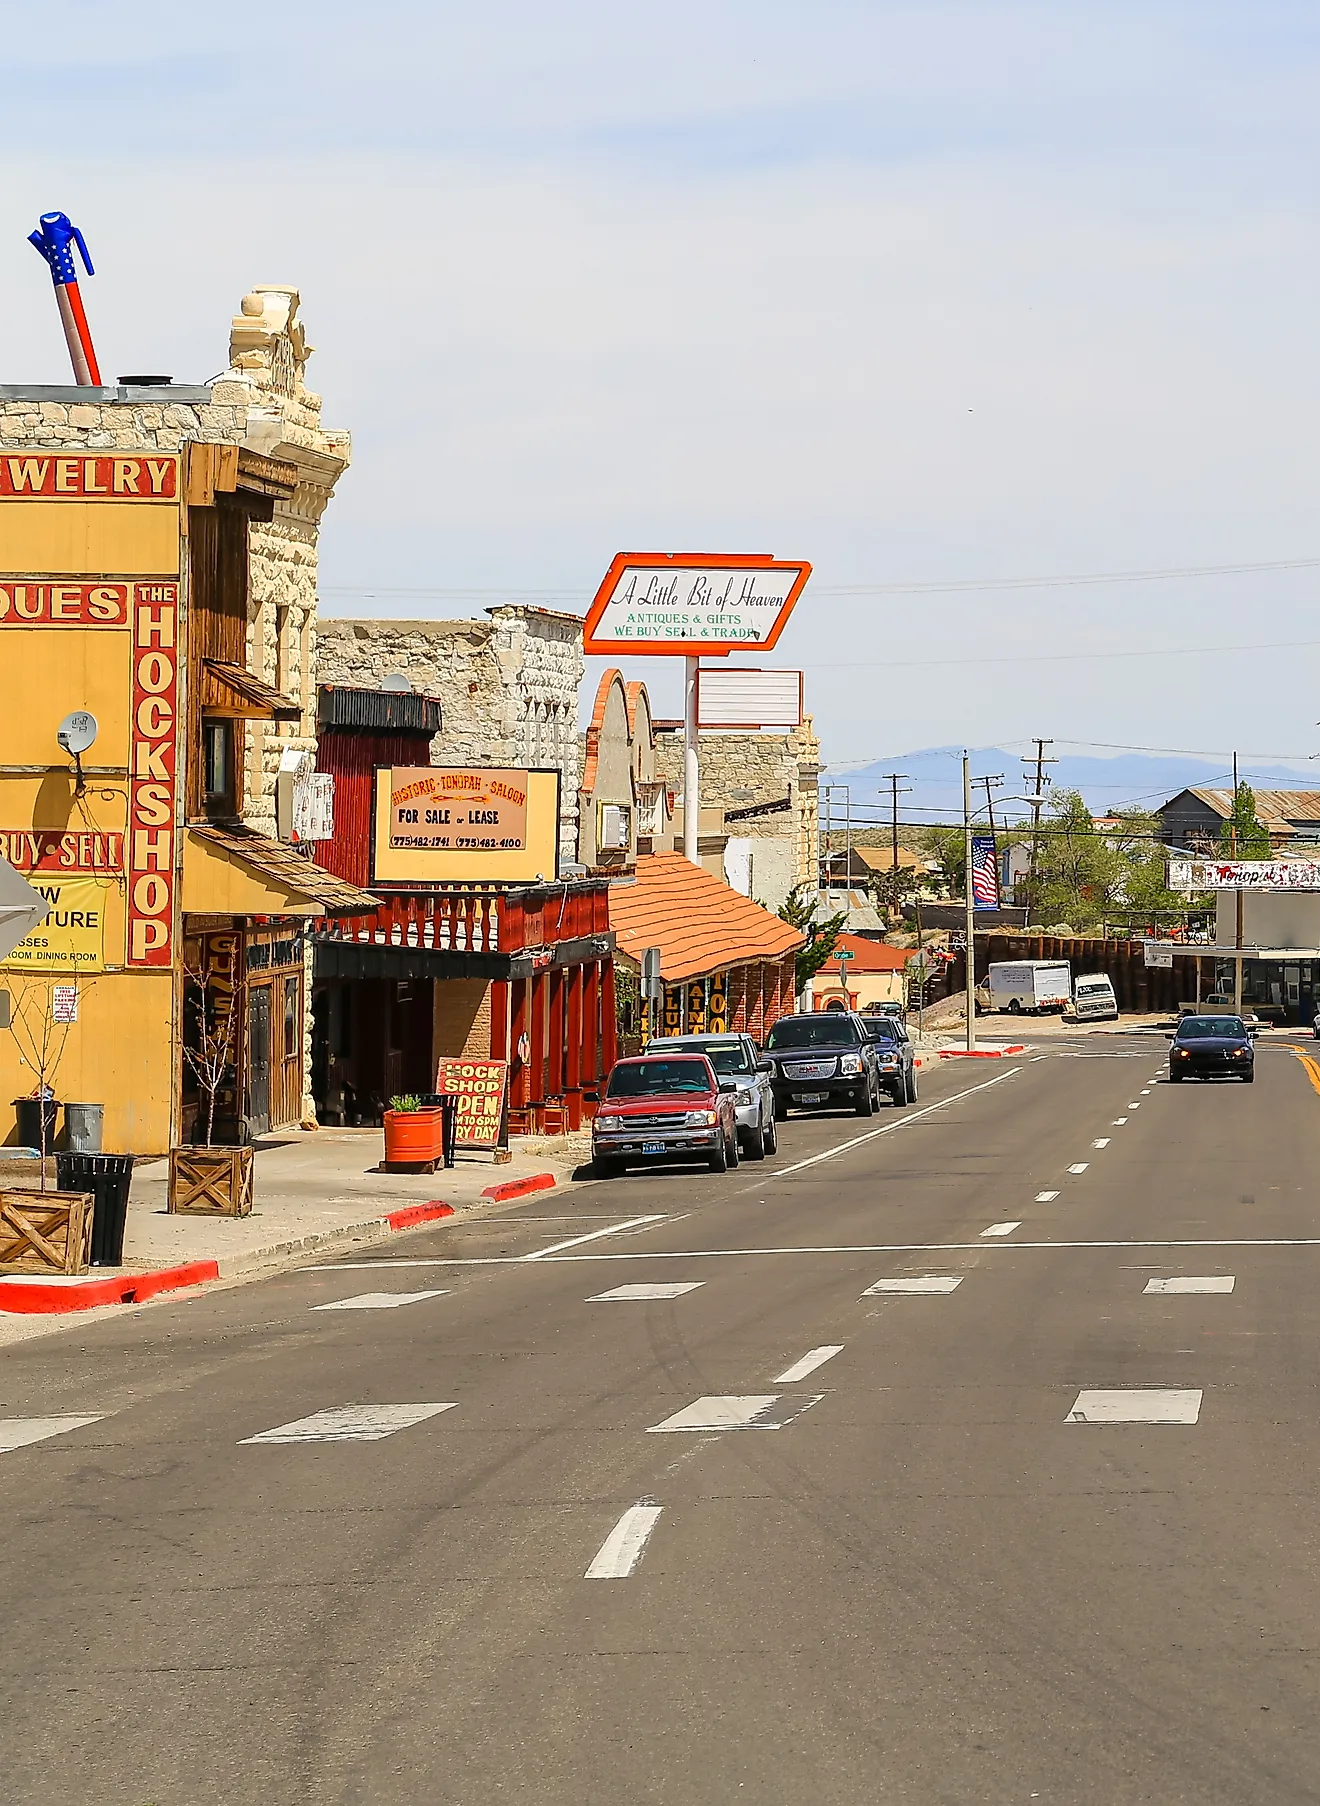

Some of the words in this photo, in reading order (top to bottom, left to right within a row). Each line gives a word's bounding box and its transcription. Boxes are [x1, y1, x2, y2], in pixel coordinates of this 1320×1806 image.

[1, 459, 172, 493] WELRY
[139, 586, 174, 602] THE
[611, 575, 637, 605] A
[637, 576, 679, 606] Little
[687, 576, 712, 606] Bit
[715, 577, 734, 613] of
[730, 577, 783, 607] Heaven
[627, 613, 689, 624] ANTIQUES
[692, 615, 702, 623] &
[707, 614, 742, 624] GIFTS
[614, 626, 633, 635] WE
[637, 626, 662, 636] BUY
[700, 628, 710, 637] &
[391, 778, 436, 806] HISTORIC
[440, 775, 481, 790] TONOPAH
[490, 781, 526, 807] SALOON
[398, 809, 419, 824] FOR
[425, 810, 450, 824] SALE
[469, 811, 499, 824] LEASE
[60, 834, 119, 867] SELL
[36, 951, 67, 960] DINING
[69, 952, 97, 961] ROOM
[445, 1065, 500, 1079] HOCK
[444, 1079, 500, 1093] SHOP
[457, 1095, 499, 1115] PEN
[474, 1126, 497, 1140] DAY
